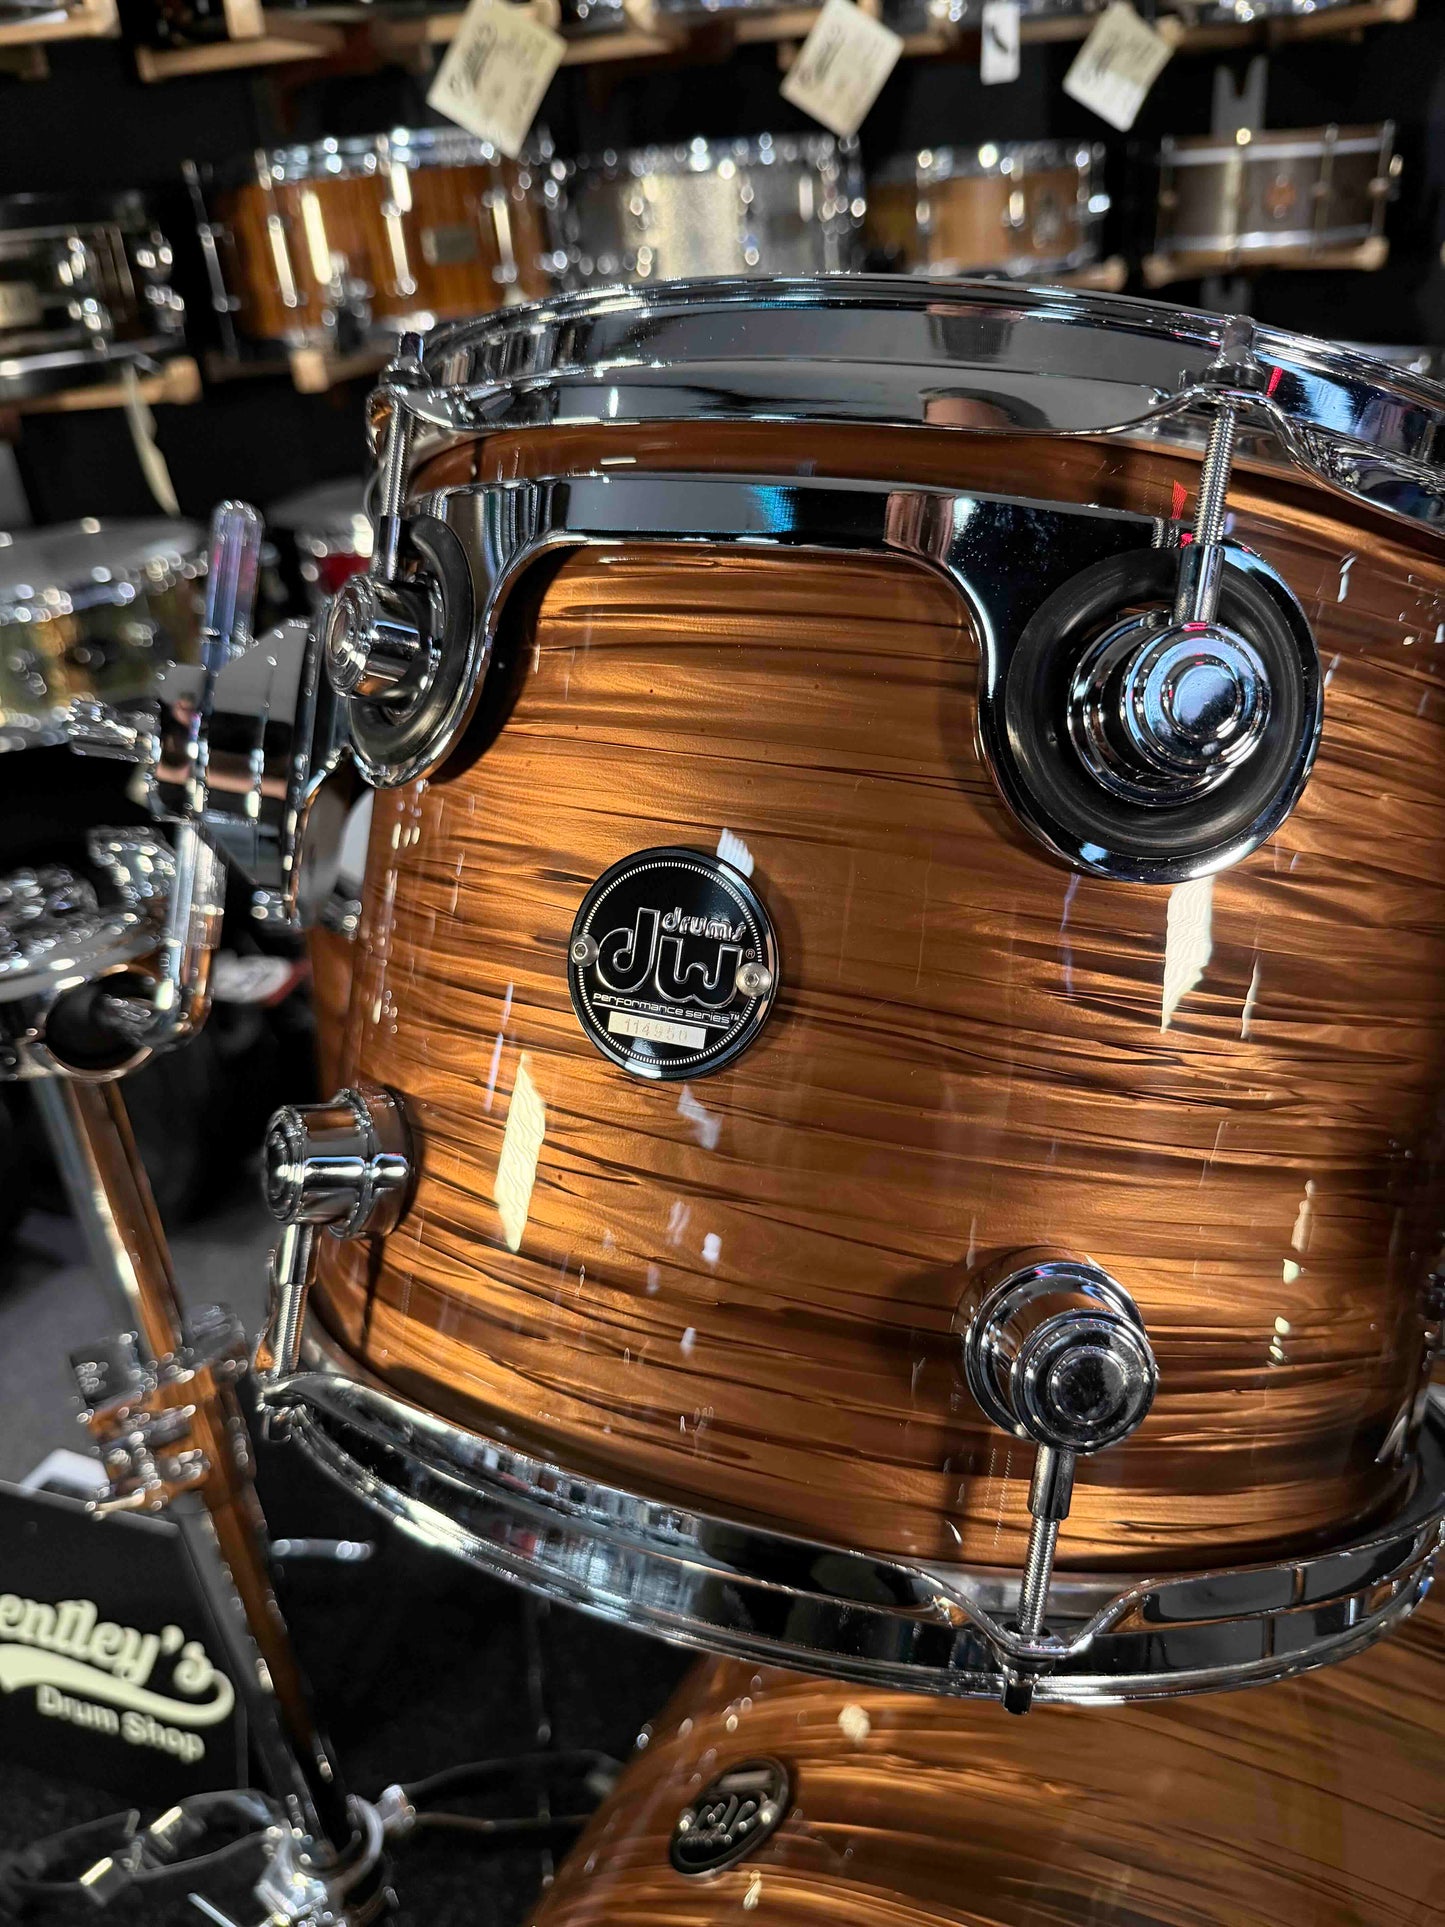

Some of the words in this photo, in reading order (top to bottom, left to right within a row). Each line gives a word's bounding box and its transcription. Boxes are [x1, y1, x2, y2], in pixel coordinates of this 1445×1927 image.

[662, 907, 747, 942] drums
[592, 993, 684, 1016] performance
[37, 1684, 120, 1735] Drum
[121, 1711, 205, 1762] Shop
